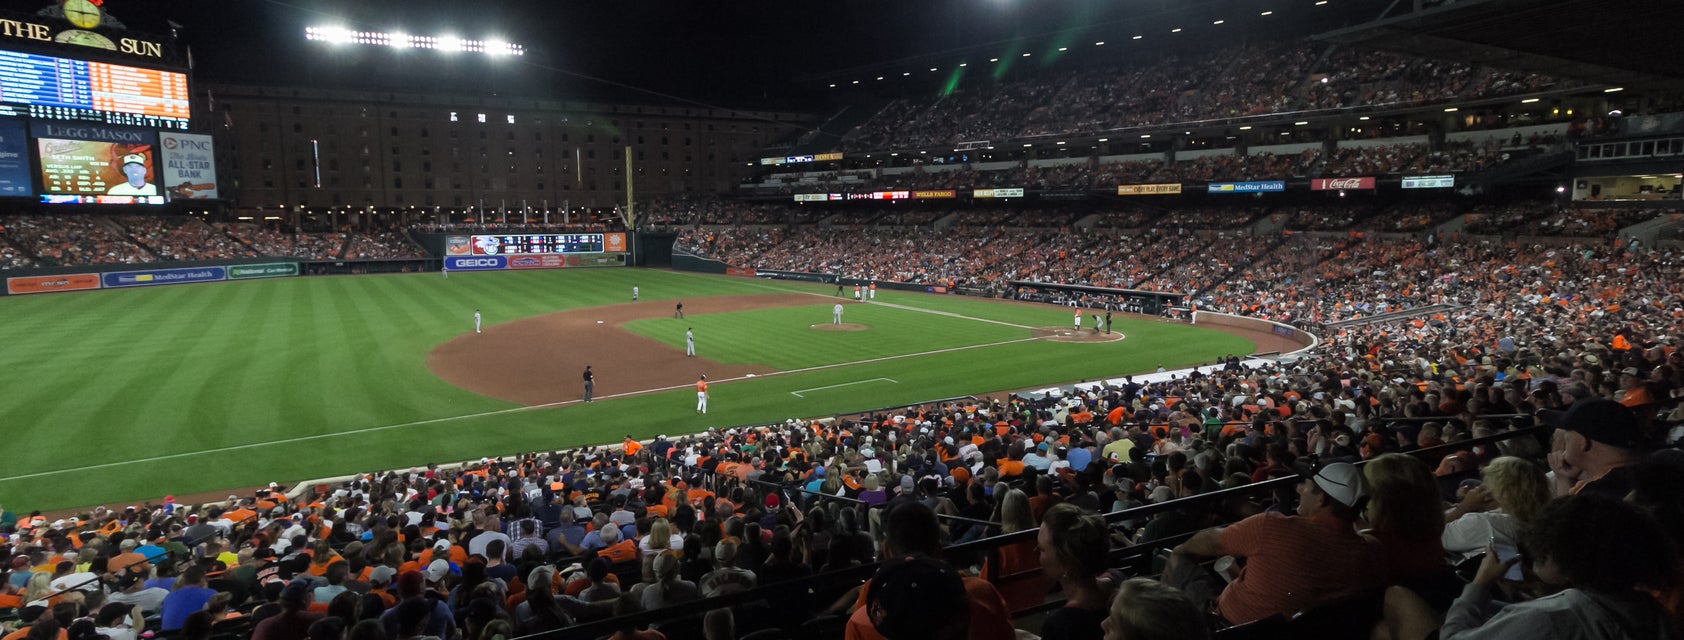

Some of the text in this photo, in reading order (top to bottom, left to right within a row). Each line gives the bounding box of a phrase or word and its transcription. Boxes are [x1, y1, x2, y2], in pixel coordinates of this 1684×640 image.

[0, 18, 52, 41] THE
[120, 37, 162, 58] SUN
[46, 124, 143, 141] LEGG MASON
[180, 139, 211, 151] PNC
[178, 169, 202, 179] BANK
[1261, 182, 1283, 190] Health
[455, 258, 499, 267] GEICO
